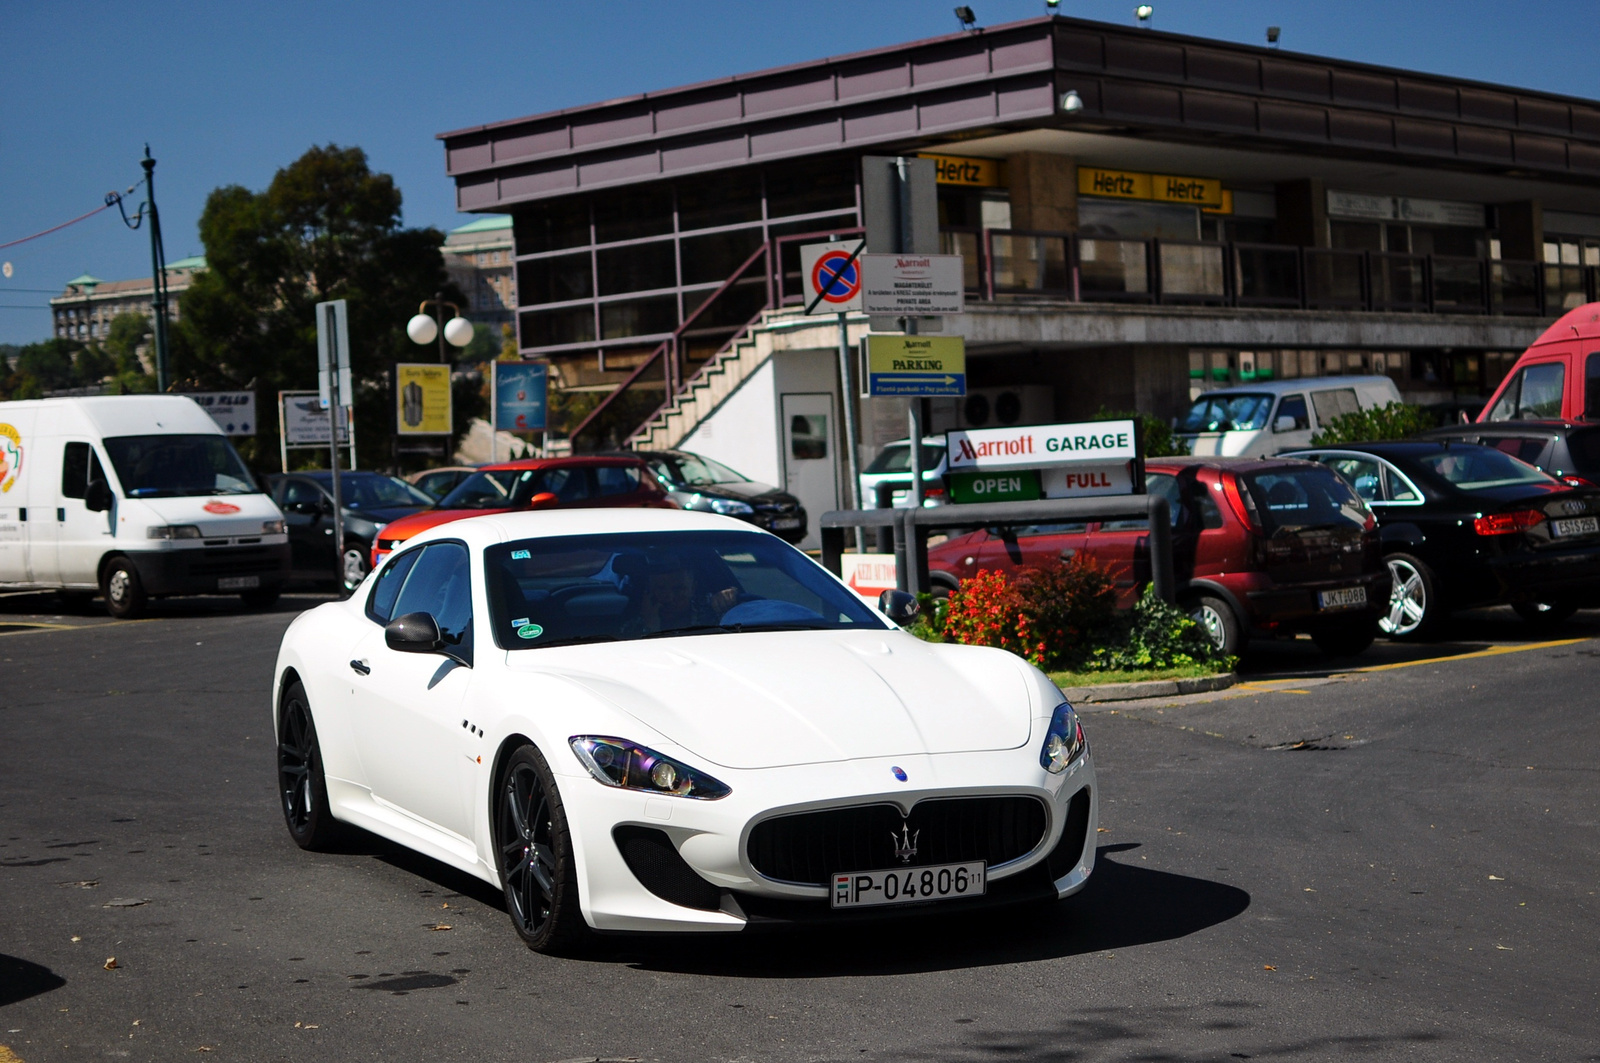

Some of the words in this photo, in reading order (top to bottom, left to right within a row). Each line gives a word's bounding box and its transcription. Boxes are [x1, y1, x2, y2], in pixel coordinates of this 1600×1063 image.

[935, 158, 981, 183] Hertz
[1093, 172, 1135, 195] Hertz
[1166, 179, 1205, 201] Hertz
[894, 258, 930, 269] Marriott
[903, 340, 931, 349] Marriott
[892, 360, 942, 370] PARKING
[954, 435, 1033, 462] Marriott
[1046, 433, 1129, 452] GARAGE
[972, 477, 1021, 494] OPEN
[1066, 472, 1112, 489] FULL
[836, 891, 849, 904] H
[855, 867, 968, 903] P-04806
